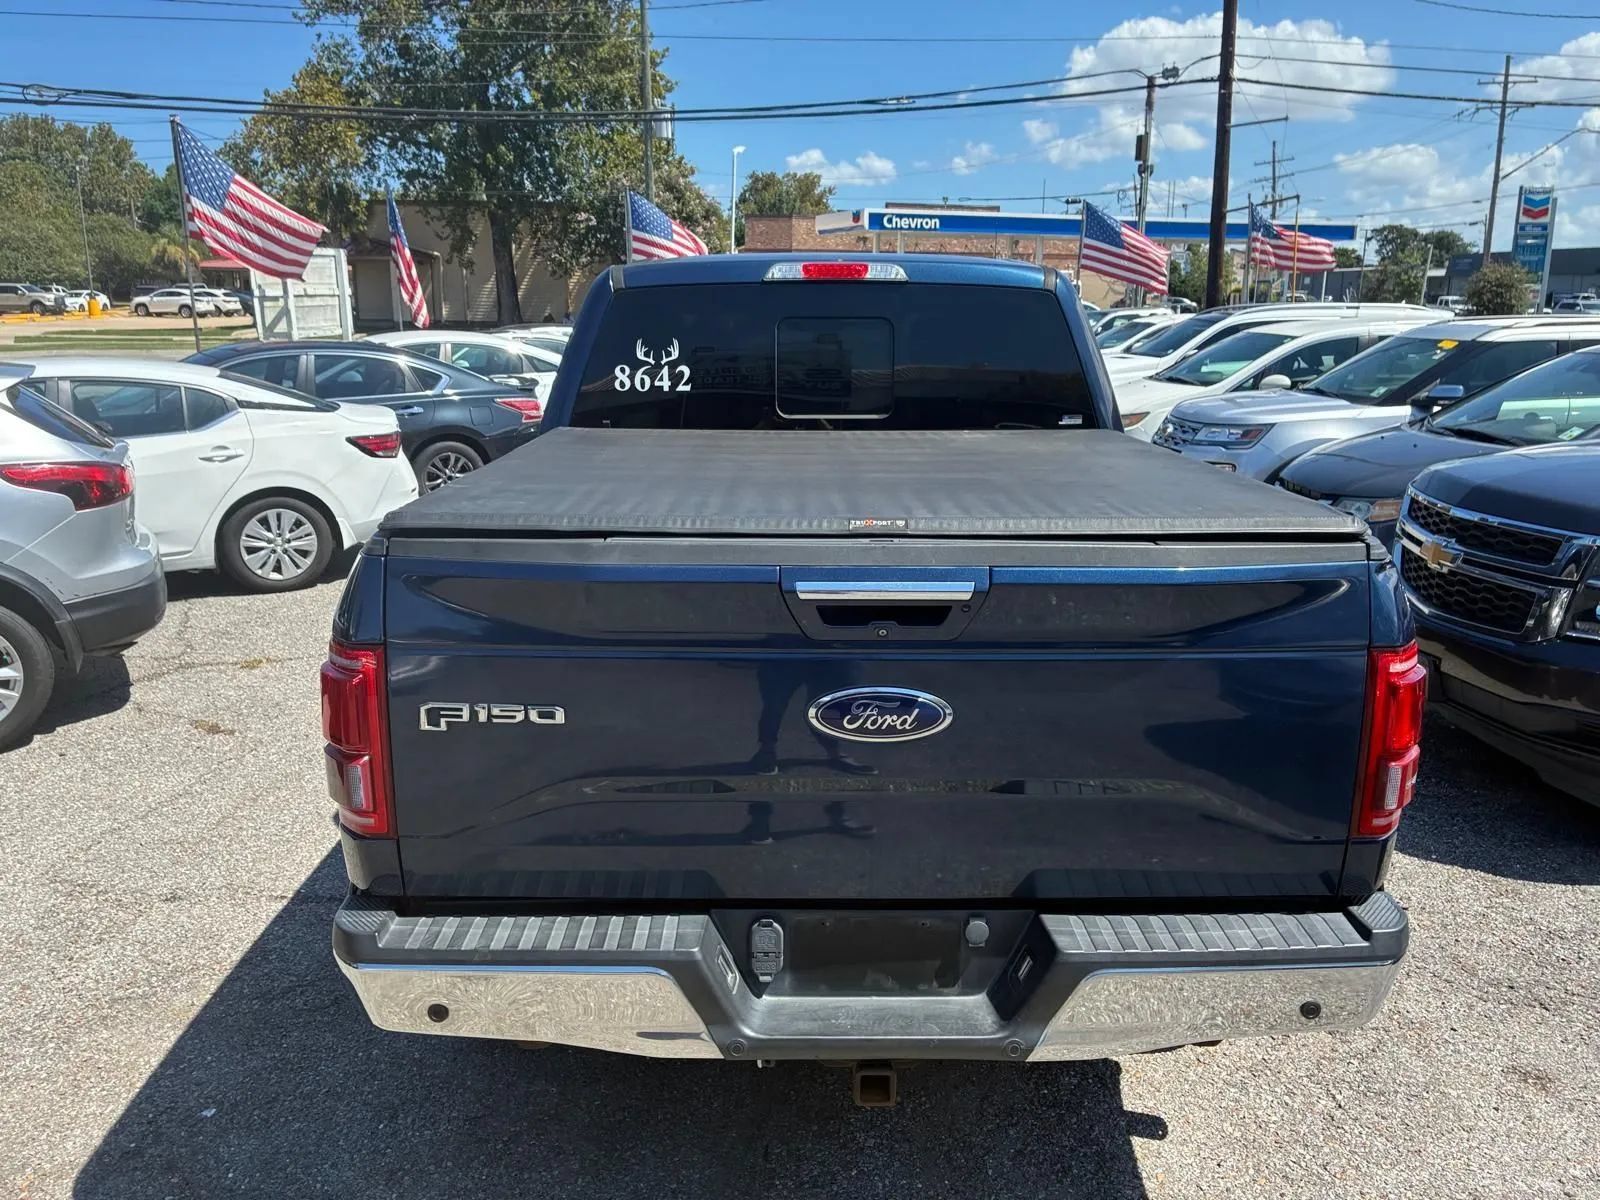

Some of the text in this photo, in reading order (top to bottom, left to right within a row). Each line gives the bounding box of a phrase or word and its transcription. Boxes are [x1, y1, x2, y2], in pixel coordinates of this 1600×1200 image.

[883, 214, 940, 229] Chevron
[614, 365, 692, 392] 8642
[843, 700, 920, 730] Ford
